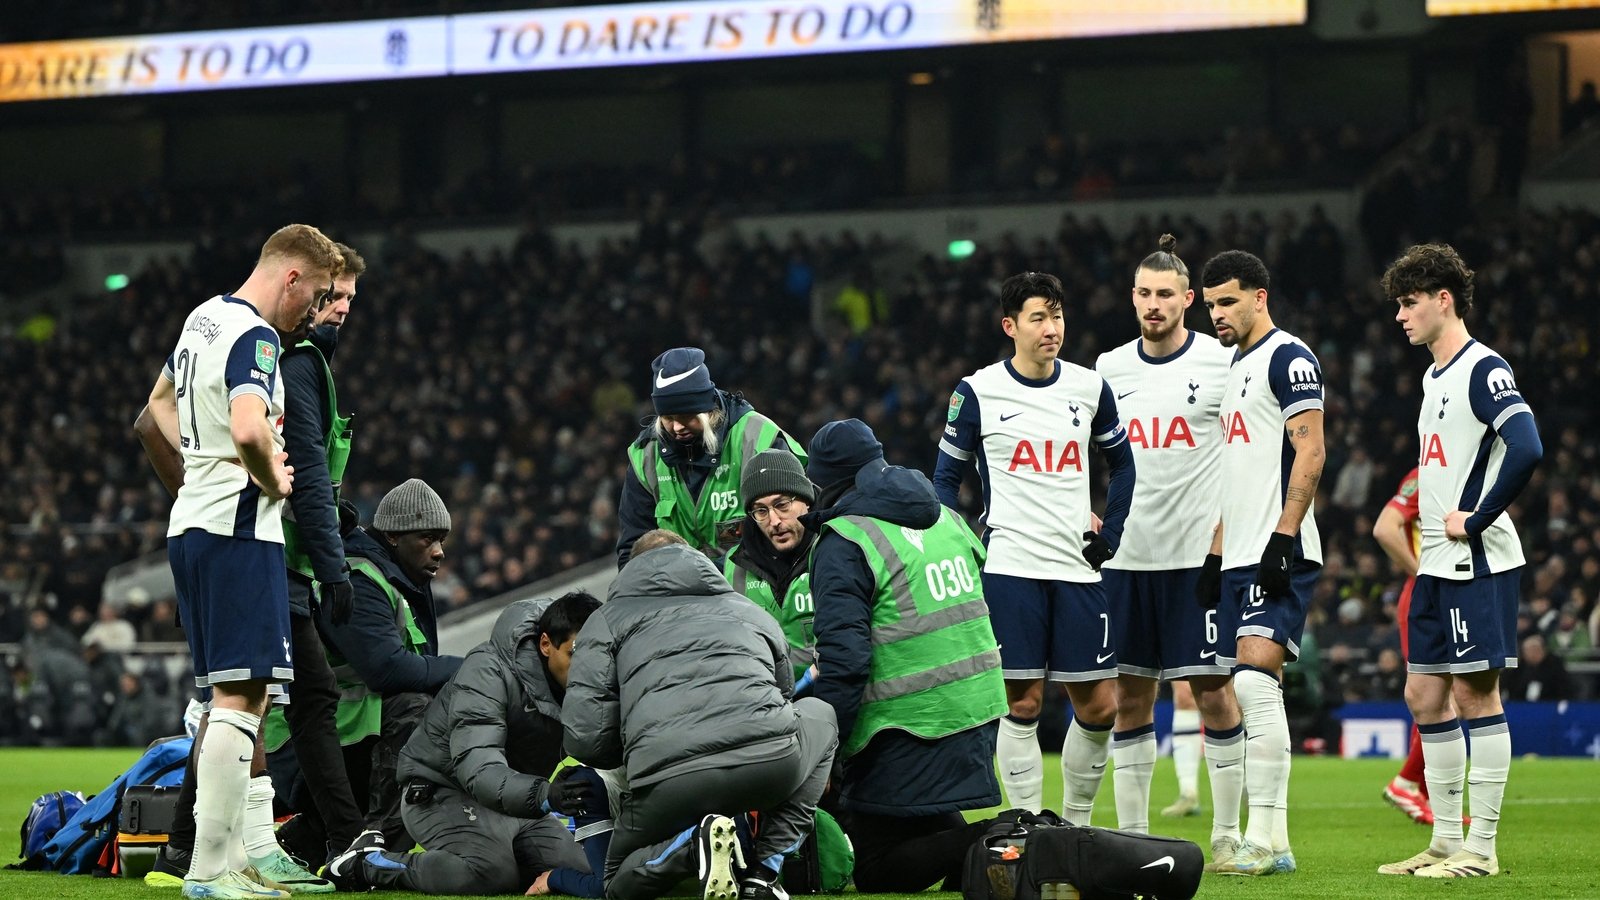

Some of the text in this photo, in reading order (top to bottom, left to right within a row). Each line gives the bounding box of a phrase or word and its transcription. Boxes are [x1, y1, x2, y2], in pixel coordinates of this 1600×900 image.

[485, 1, 913, 61] TO DARE IS TO DO
[122, 46, 161, 85] IS
[177, 40, 232, 82] TO
[244, 36, 311, 76] DO
[177, 348, 200, 450] 21
[1128, 415, 1196, 448] AIA
[1008, 440, 1083, 472] AIA
[1421, 433, 1447, 467] IA
[710, 490, 739, 511] 035
[925, 555, 974, 602] 030
[794, 593, 814, 613] 01
[1100, 613, 1109, 648] 7
[1205, 609, 1218, 644] 6
[1450, 607, 1468, 644] 14
